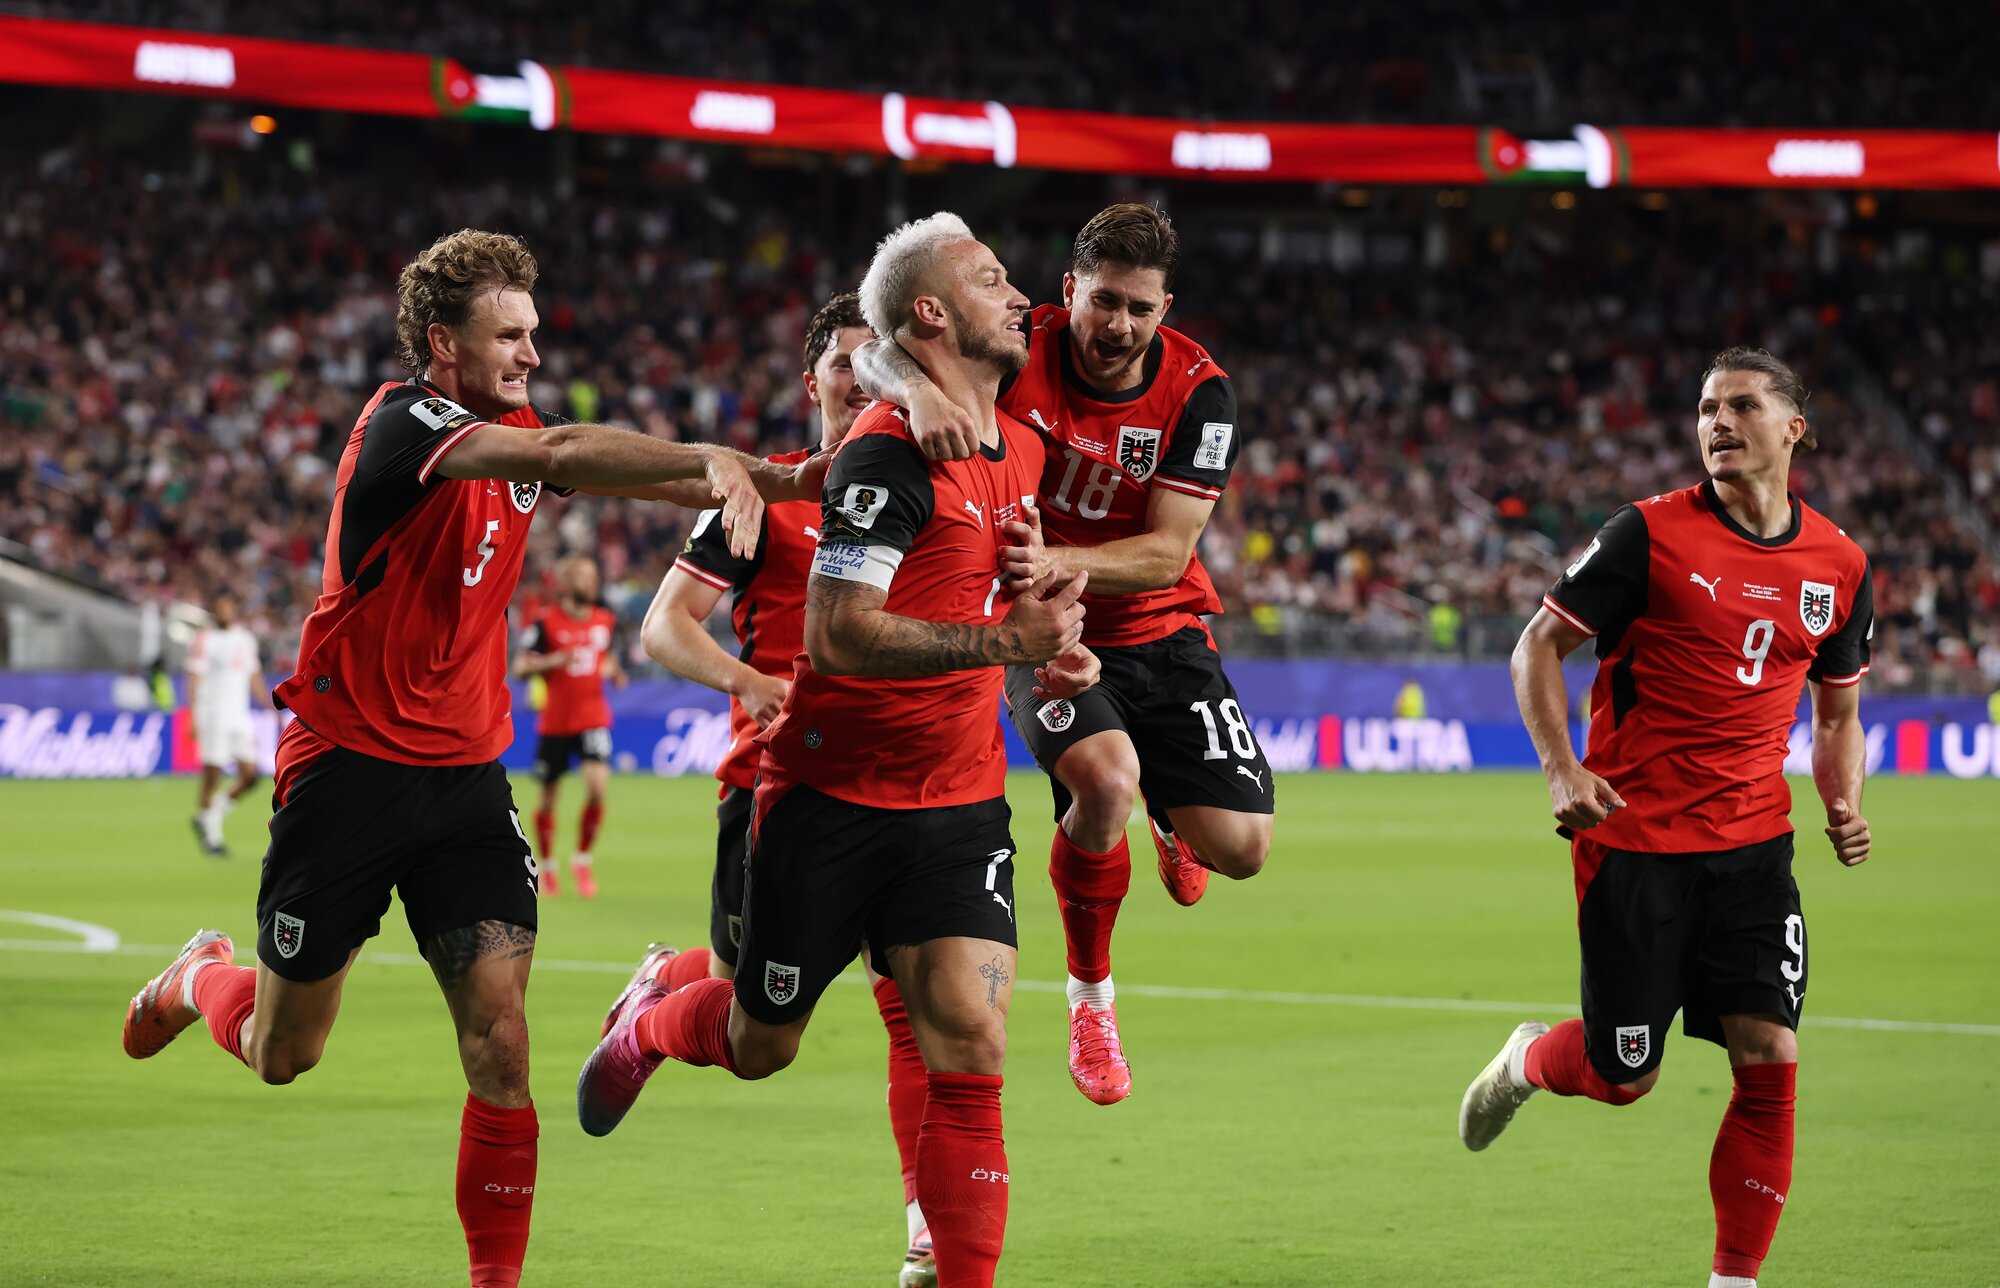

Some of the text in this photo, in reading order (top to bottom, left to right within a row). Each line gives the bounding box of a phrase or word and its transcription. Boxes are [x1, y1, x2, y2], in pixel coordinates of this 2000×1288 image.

[1047, 448, 1123, 520] 18
[844, 511, 863, 523] 2026
[463, 520, 500, 587] 5
[822, 565, 841, 575] FIFA
[828, 553, 866, 570] World
[1736, 619, 1775, 686] 9
[1190, 698, 1257, 760] 18
[1343, 716, 1474, 773] ULTRA
[1780, 914, 1803, 983] 9
[484, 1183, 533, 1194] ÖFB
[970, 1168, 1010, 1184] ÖFB
[1744, 1178, 1785, 1204] ÖFB
